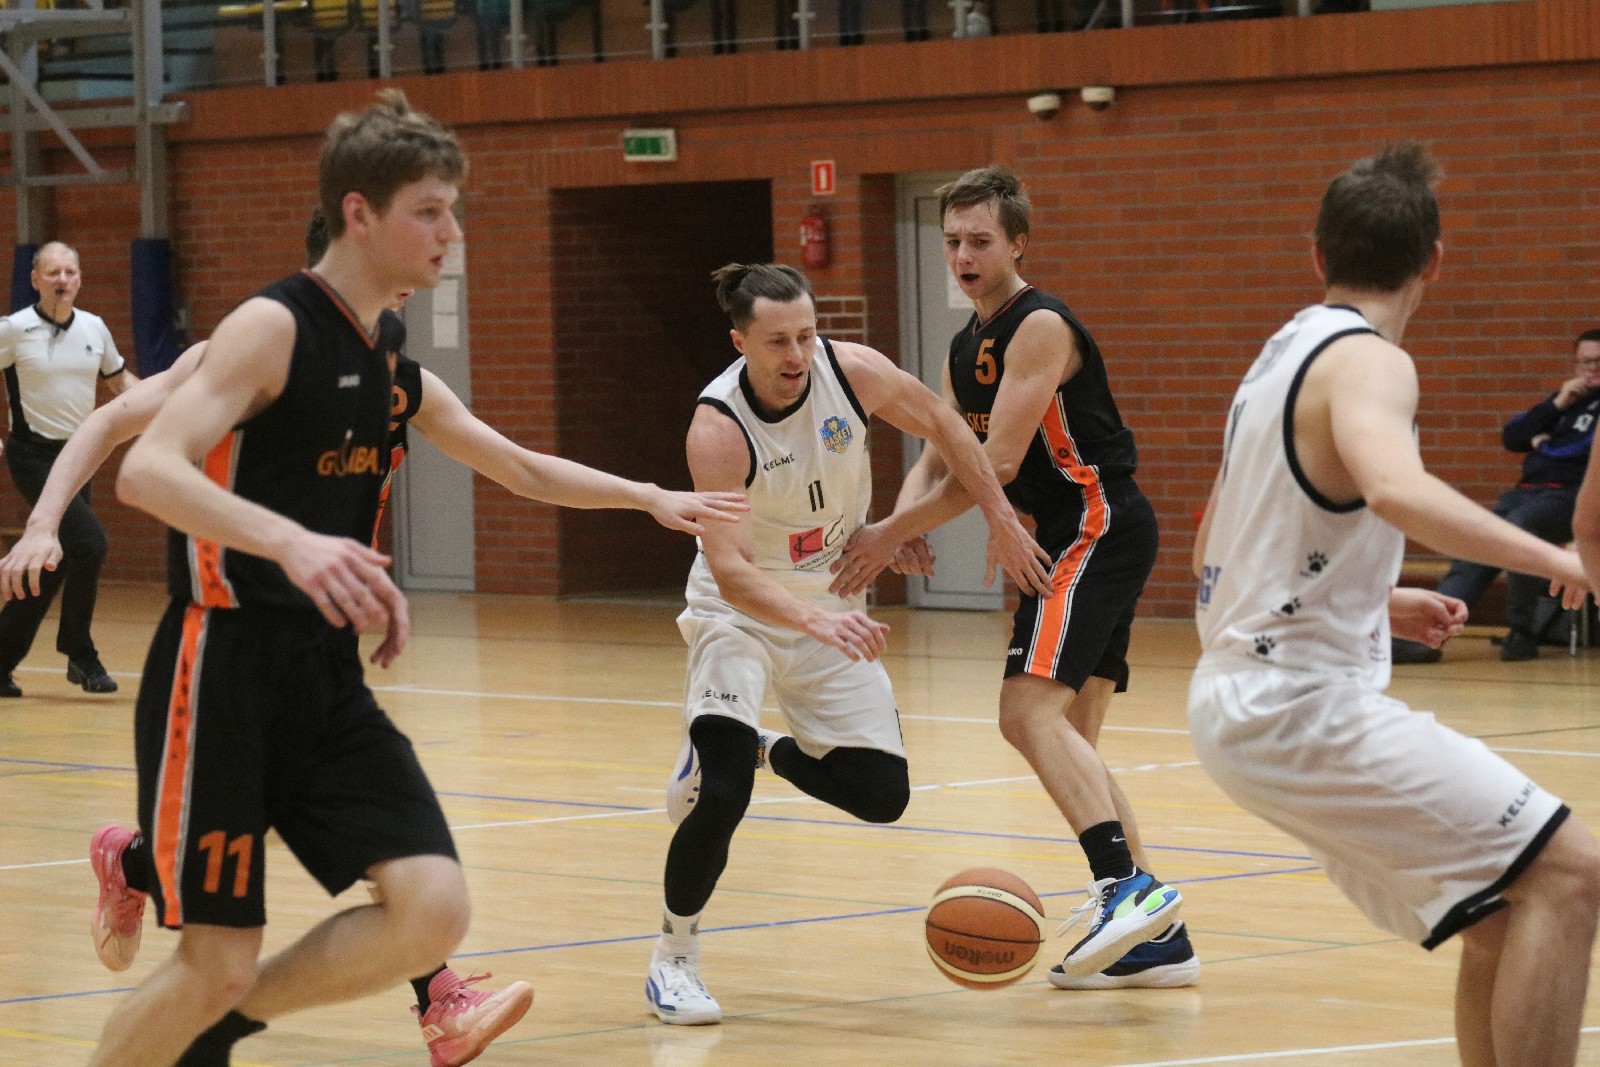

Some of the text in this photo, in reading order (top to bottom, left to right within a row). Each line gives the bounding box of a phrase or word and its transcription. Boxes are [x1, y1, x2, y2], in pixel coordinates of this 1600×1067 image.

[974, 338, 997, 385] 5
[965, 412, 991, 433] SKE
[763, 453, 795, 472] KELME
[808, 480, 825, 512] 11
[702, 689, 739, 703] ELME
[198, 830, 253, 897] 11
[944, 940, 1015, 966] molten
